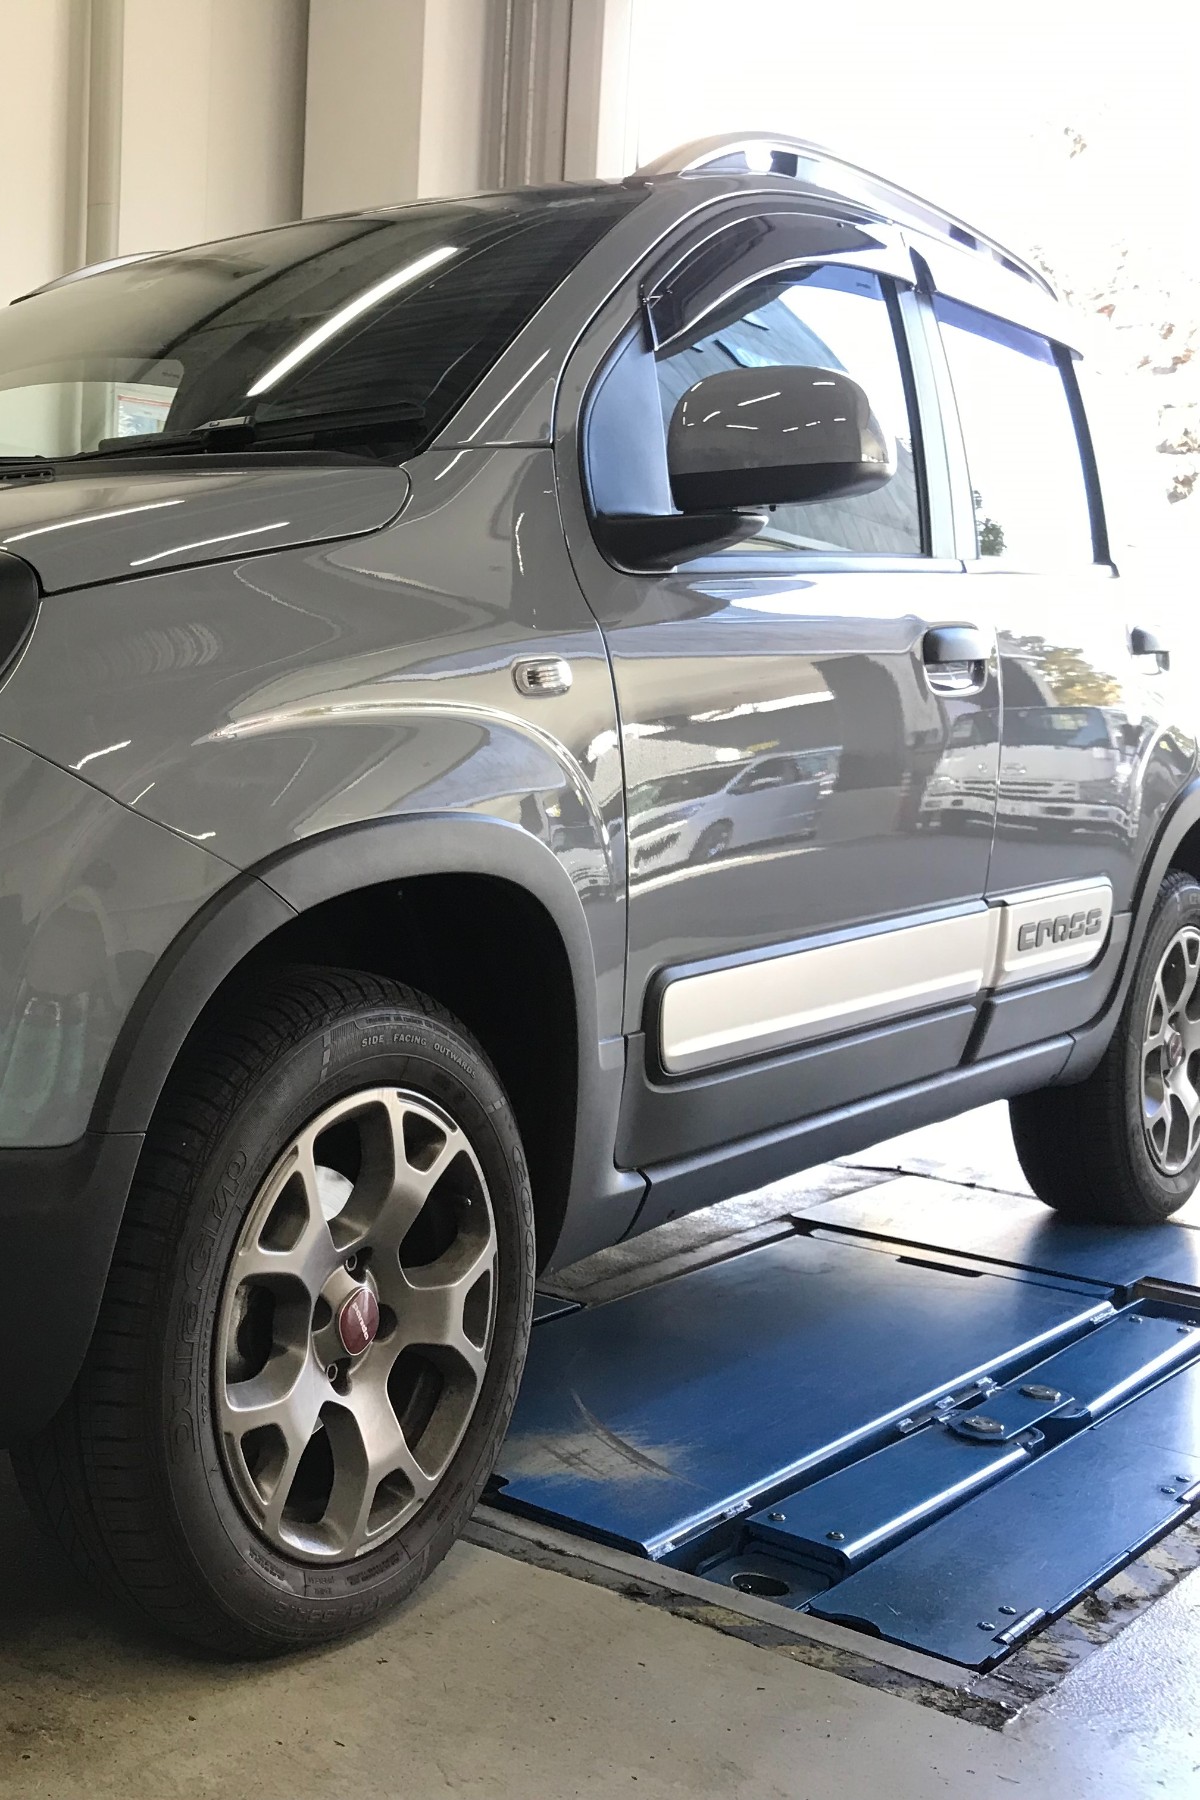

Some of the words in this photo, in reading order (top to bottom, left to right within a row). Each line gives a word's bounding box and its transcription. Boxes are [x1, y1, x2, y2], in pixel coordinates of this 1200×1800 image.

[361, 1034, 385, 1048] SIDE
[393, 1033, 427, 1047] FACING
[433, 1042, 477, 1080] OUTWARDS
[351, 1302, 369, 1341] panda
